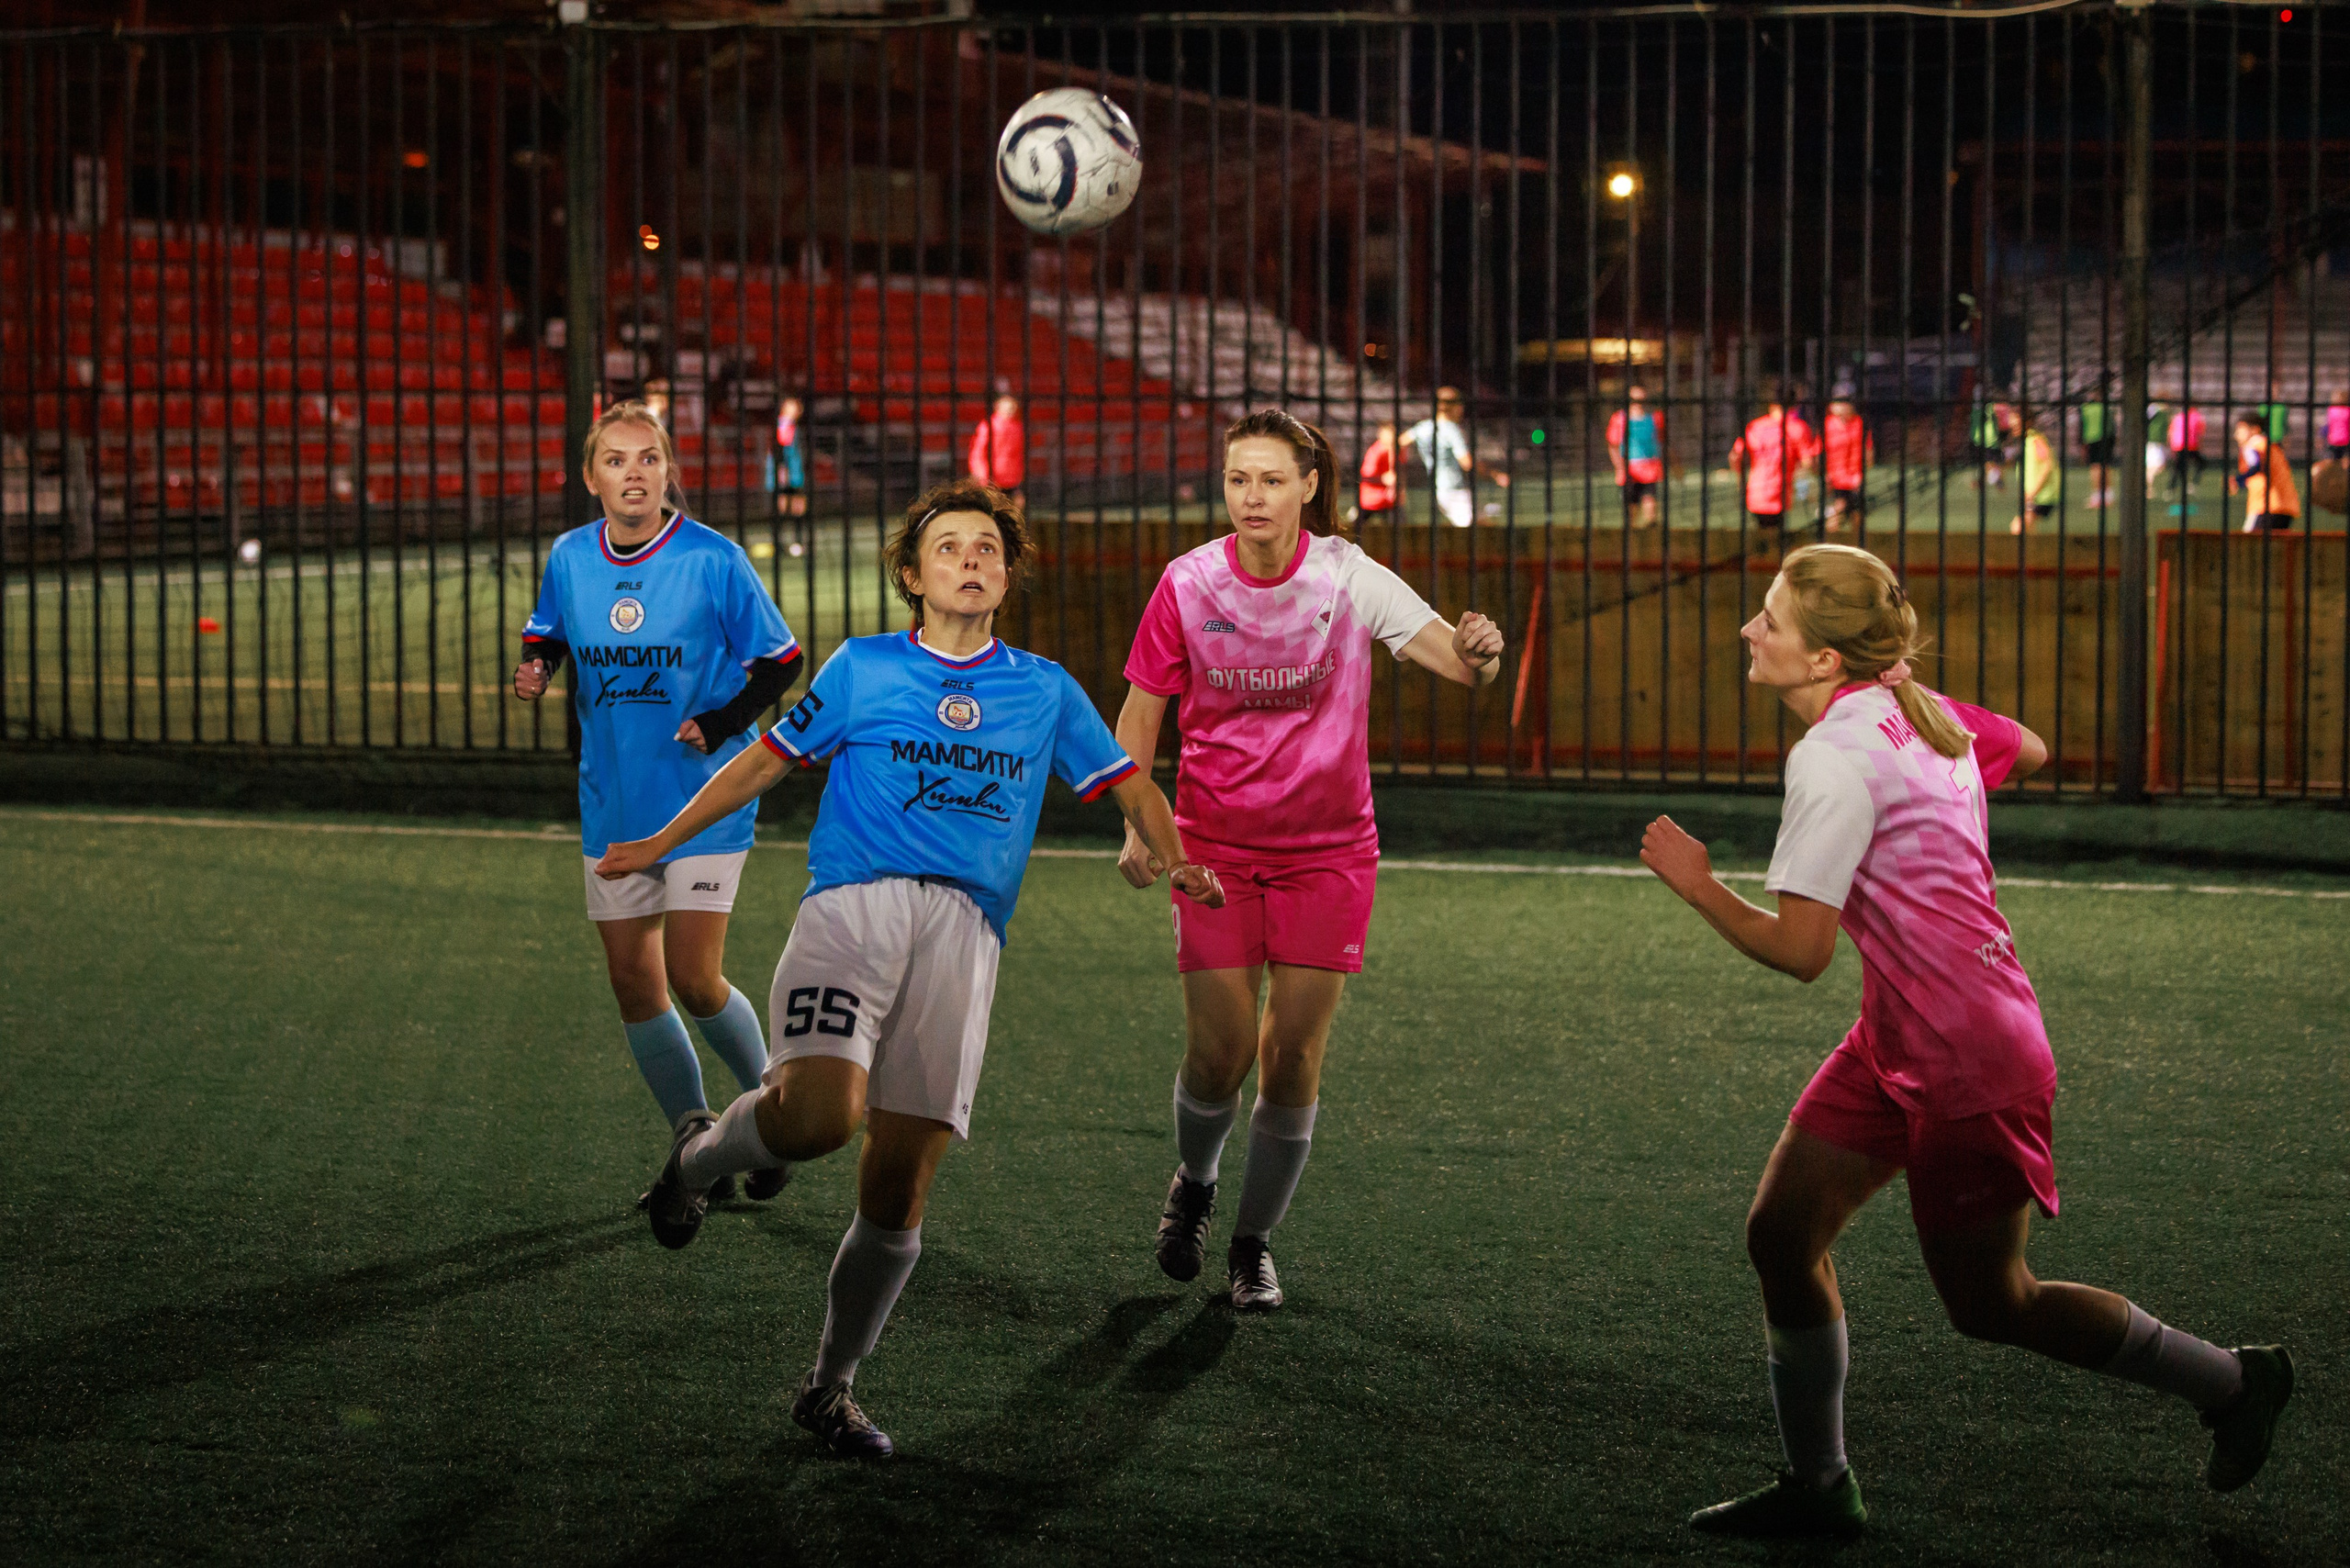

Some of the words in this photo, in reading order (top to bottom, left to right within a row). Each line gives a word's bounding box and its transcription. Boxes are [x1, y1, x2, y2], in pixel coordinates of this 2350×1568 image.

[577, 645, 683, 667] МАМСИТИ
[1206, 649, 1337, 691] ФУТБОЛЬНЫЕ
[595, 672, 671, 708] Химки
[890, 740, 1024, 782] МАМСИТИ
[903, 770, 1012, 823] Химки
[783, 986, 861, 1038] 55
